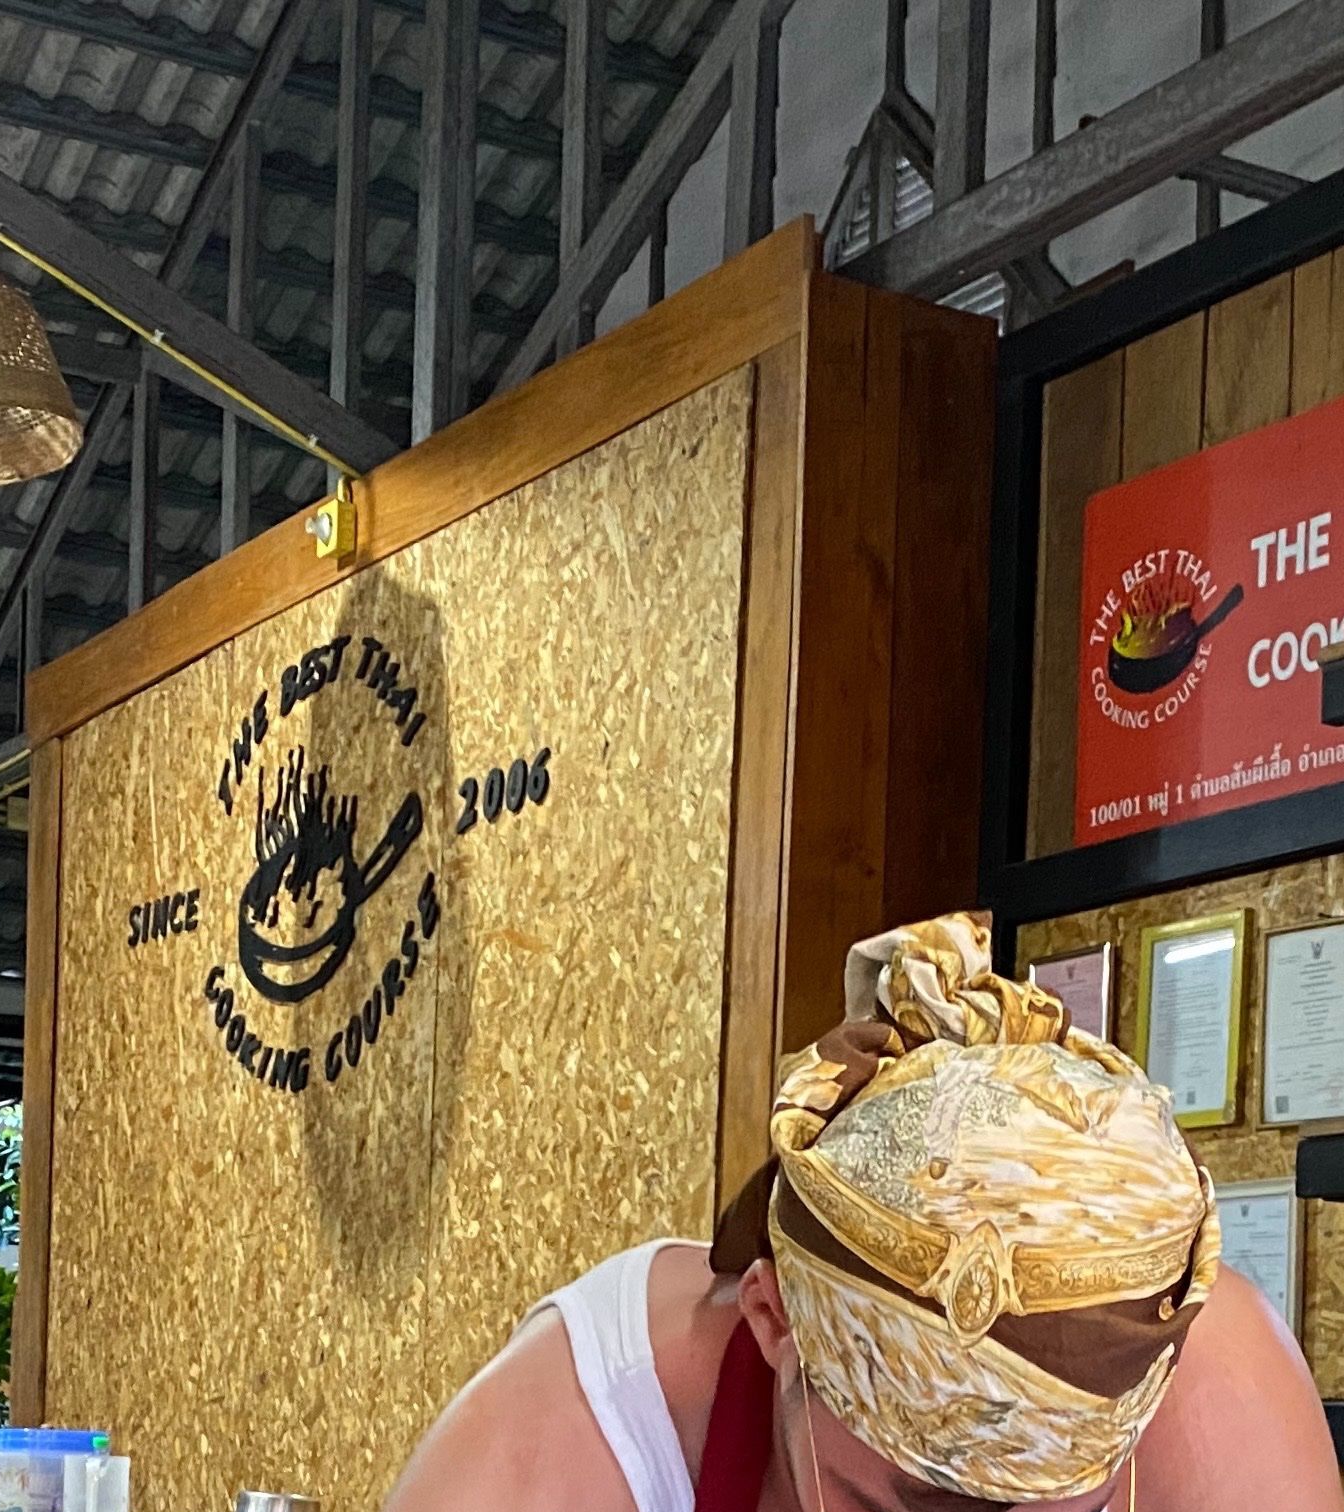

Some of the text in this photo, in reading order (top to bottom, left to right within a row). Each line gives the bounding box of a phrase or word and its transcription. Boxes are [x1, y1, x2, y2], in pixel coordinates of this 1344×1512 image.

[1250, 511, 1331, 588] THE
[1090, 549, 1217, 646] THE BEST THAI
[218, 635, 427, 816] THE BEST THAI
[1091, 643, 1212, 729] COOKING COURSE
[456, 747, 552, 834] 2006
[1089, 795, 1141, 827] 100/01
[1175, 784, 1184, 804] 1
[127, 888, 200, 947] SINCE
[205, 872, 441, 1094] COOKING COURSE
